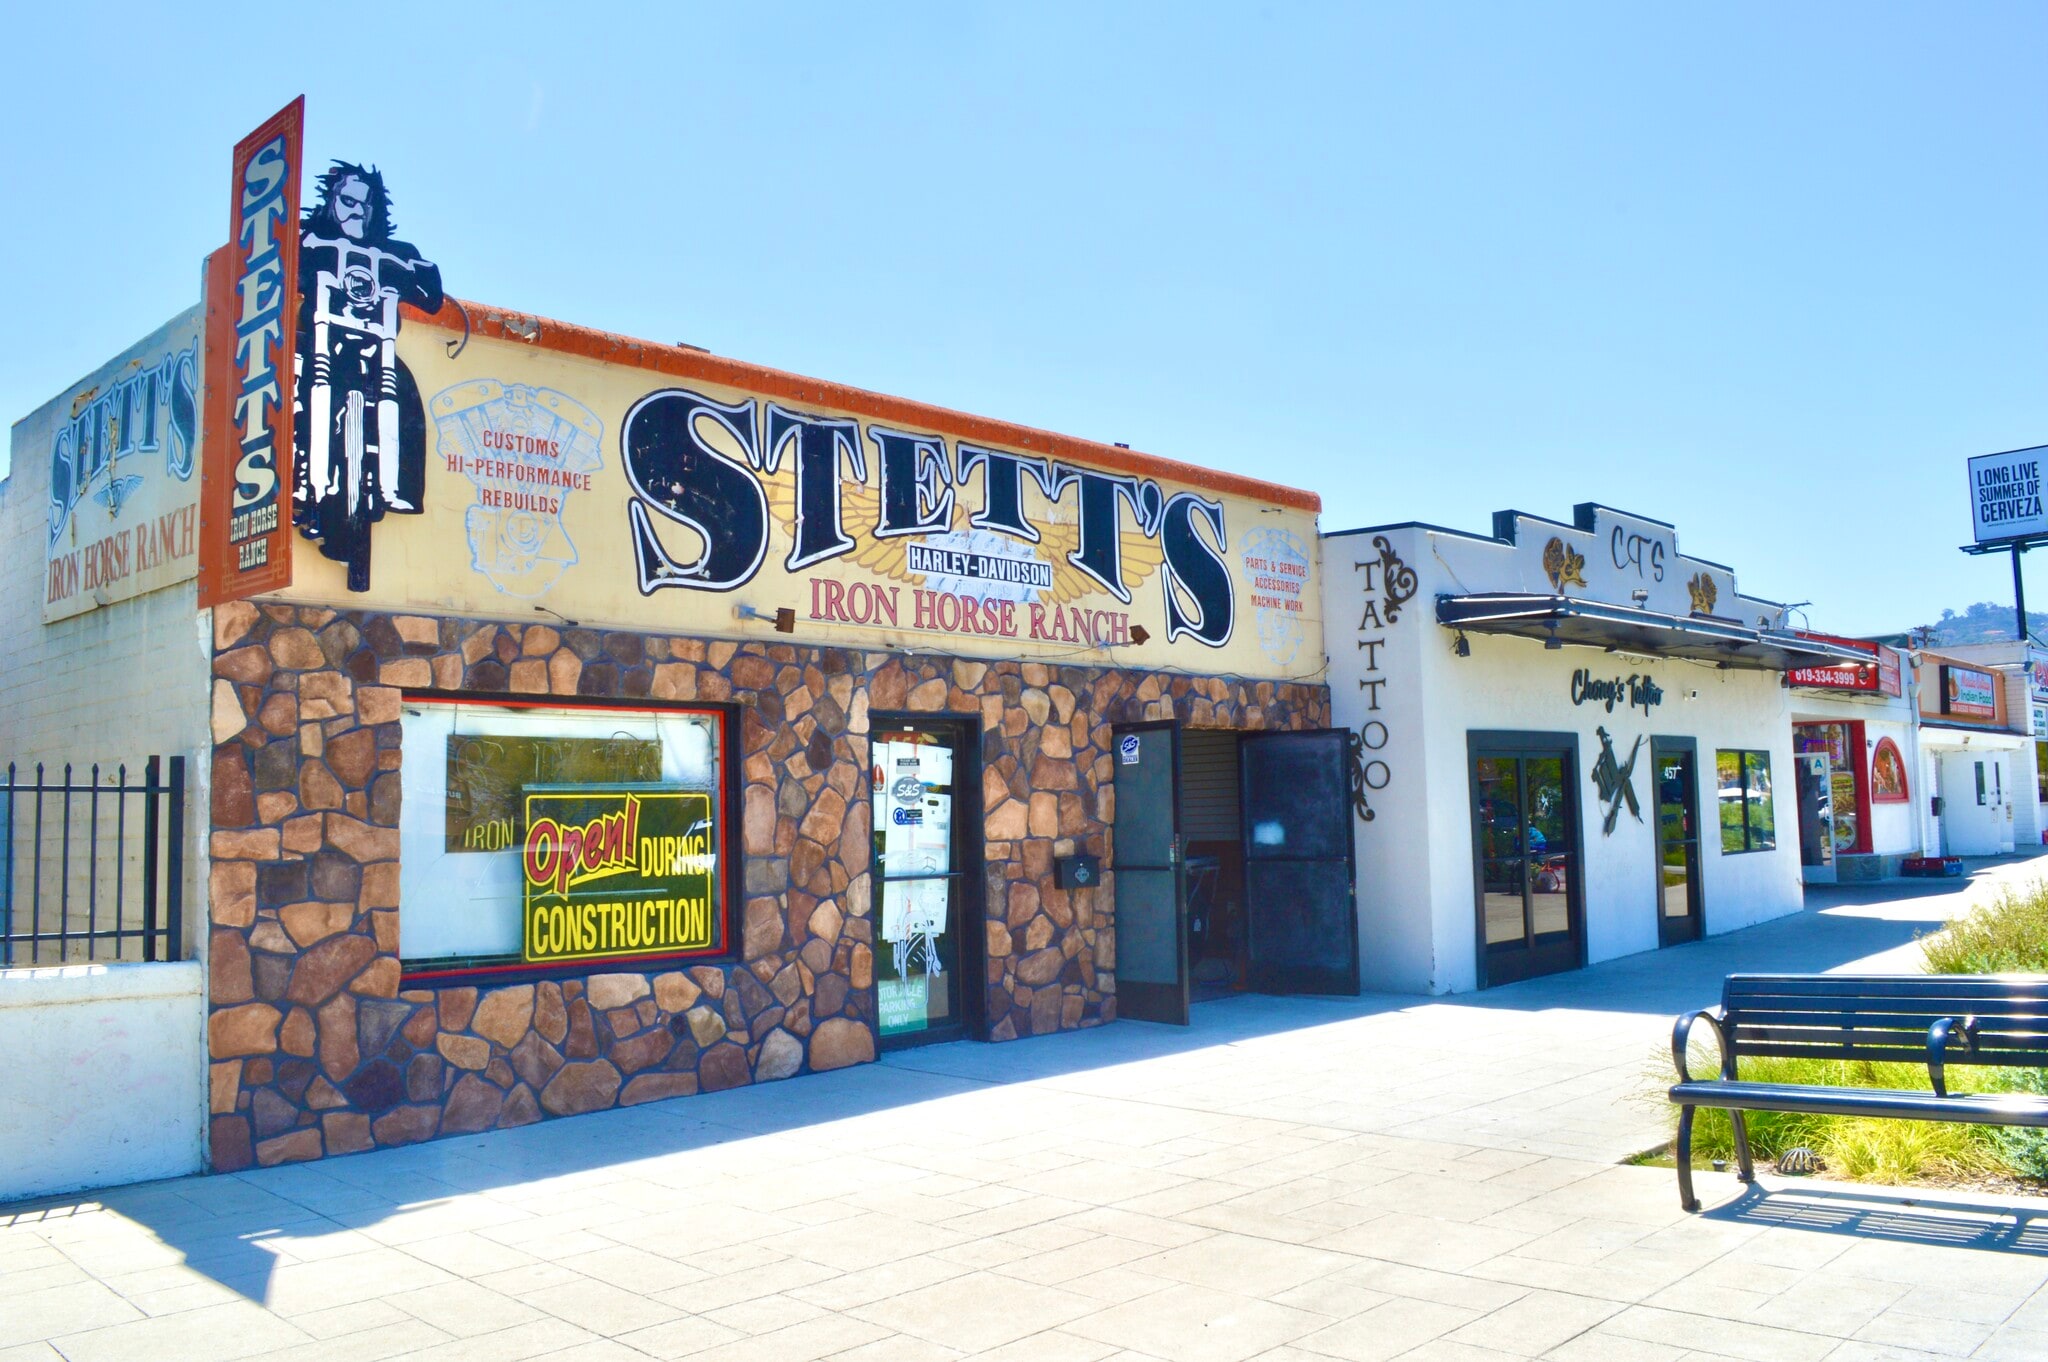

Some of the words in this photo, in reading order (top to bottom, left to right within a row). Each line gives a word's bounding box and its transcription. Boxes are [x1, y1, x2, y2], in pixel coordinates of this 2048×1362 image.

[233, 134, 287, 509] STETTS
[483, 430, 559, 458] CUSTOMS
[447, 454, 592, 491] HI-PERFORMANCE
[1977, 466, 2009, 487] LONG
[2012, 461, 2039, 482] LIVE
[482, 488, 559, 515] REBUILDS
[1979, 482, 2025, 503] SUMMER
[2027, 479, 2041, 496] OF
[230, 513, 249, 543] IRON
[251, 503, 278, 536] HORSE
[621, 387, 1235, 648] STETT'S
[1980, 496, 2043, 524] CERVEZA
[47, 550, 80, 604] IRON
[84, 528, 131, 592] HORSE
[136, 503, 197, 572] RANCH
[239, 538, 267, 570] RANCH
[911, 547, 1050, 586] HARLEY-DAVIDSON
[1245, 557, 1268, 571] PARTS
[1271, 561, 1276, 573] &
[1279, 561, 1306, 577] SERVICE
[1254, 577, 1300, 594] ACCESSORIES
[809, 578, 900, 627] IRON
[913, 589, 1018, 638] HORSE
[1028, 603, 1130, 647] RANCH
[1250, 595, 1281, 609] MACHINE
[1285, 599, 1304, 612] WORK
[1355, 558, 1391, 789] TATTOO
[1795, 668, 1855, 685] 619-334-3999
[1664, 766, 1680, 779] 457
[1814, 759, 1823, 768] A
[896, 784, 920, 797] S&S
[464, 817, 514, 851] IRON
[523, 792, 641, 901] Open!
[641, 835, 705, 877] DURING
[533, 898, 705, 955] CONSTRUCTION
